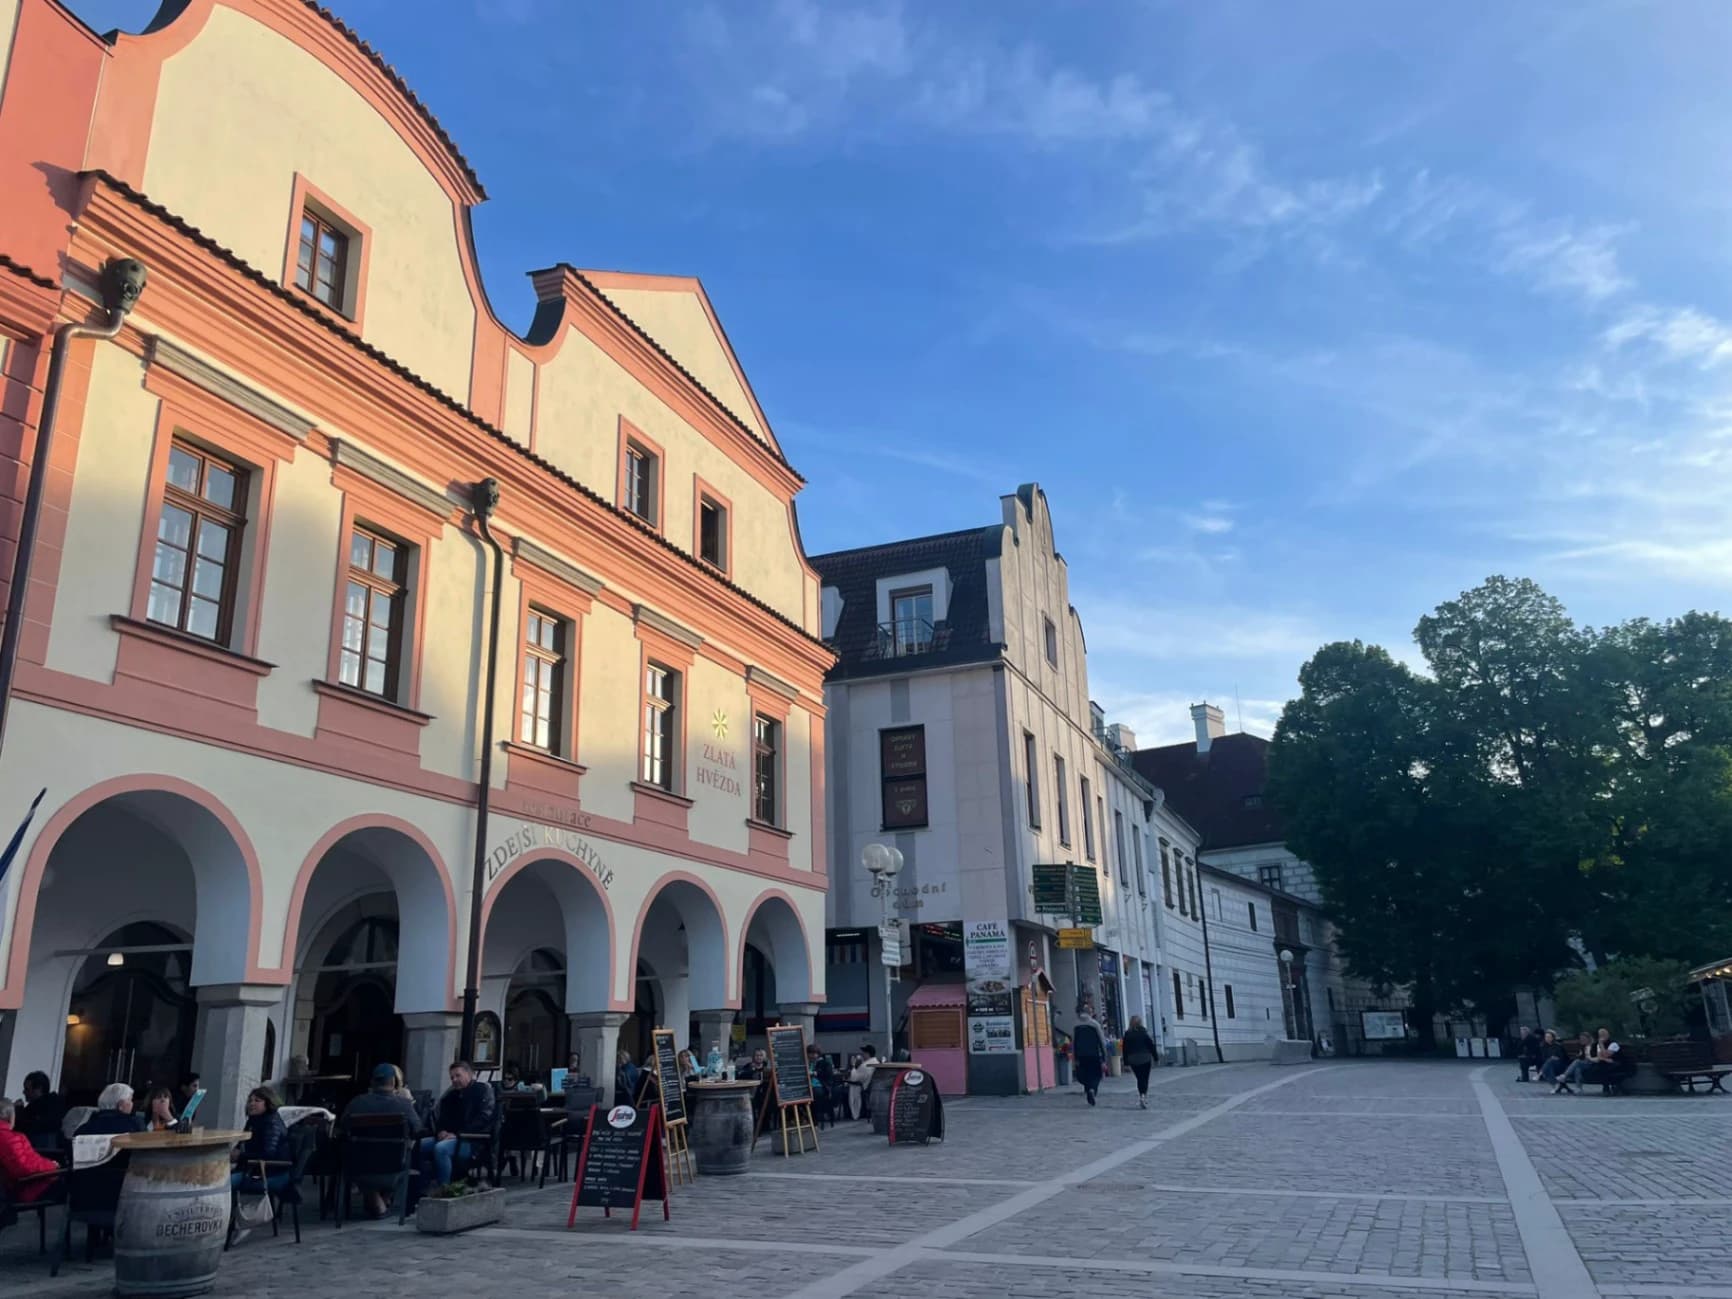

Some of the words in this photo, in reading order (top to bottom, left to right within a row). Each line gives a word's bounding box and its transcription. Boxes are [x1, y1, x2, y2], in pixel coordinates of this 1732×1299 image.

[703, 743, 736, 769] ZLATÁ
[696, 767, 741, 797] HVĚZDA
[543, 826, 615, 890] KUCHYNĚ
[970, 930, 1006, 938] PANAMA
